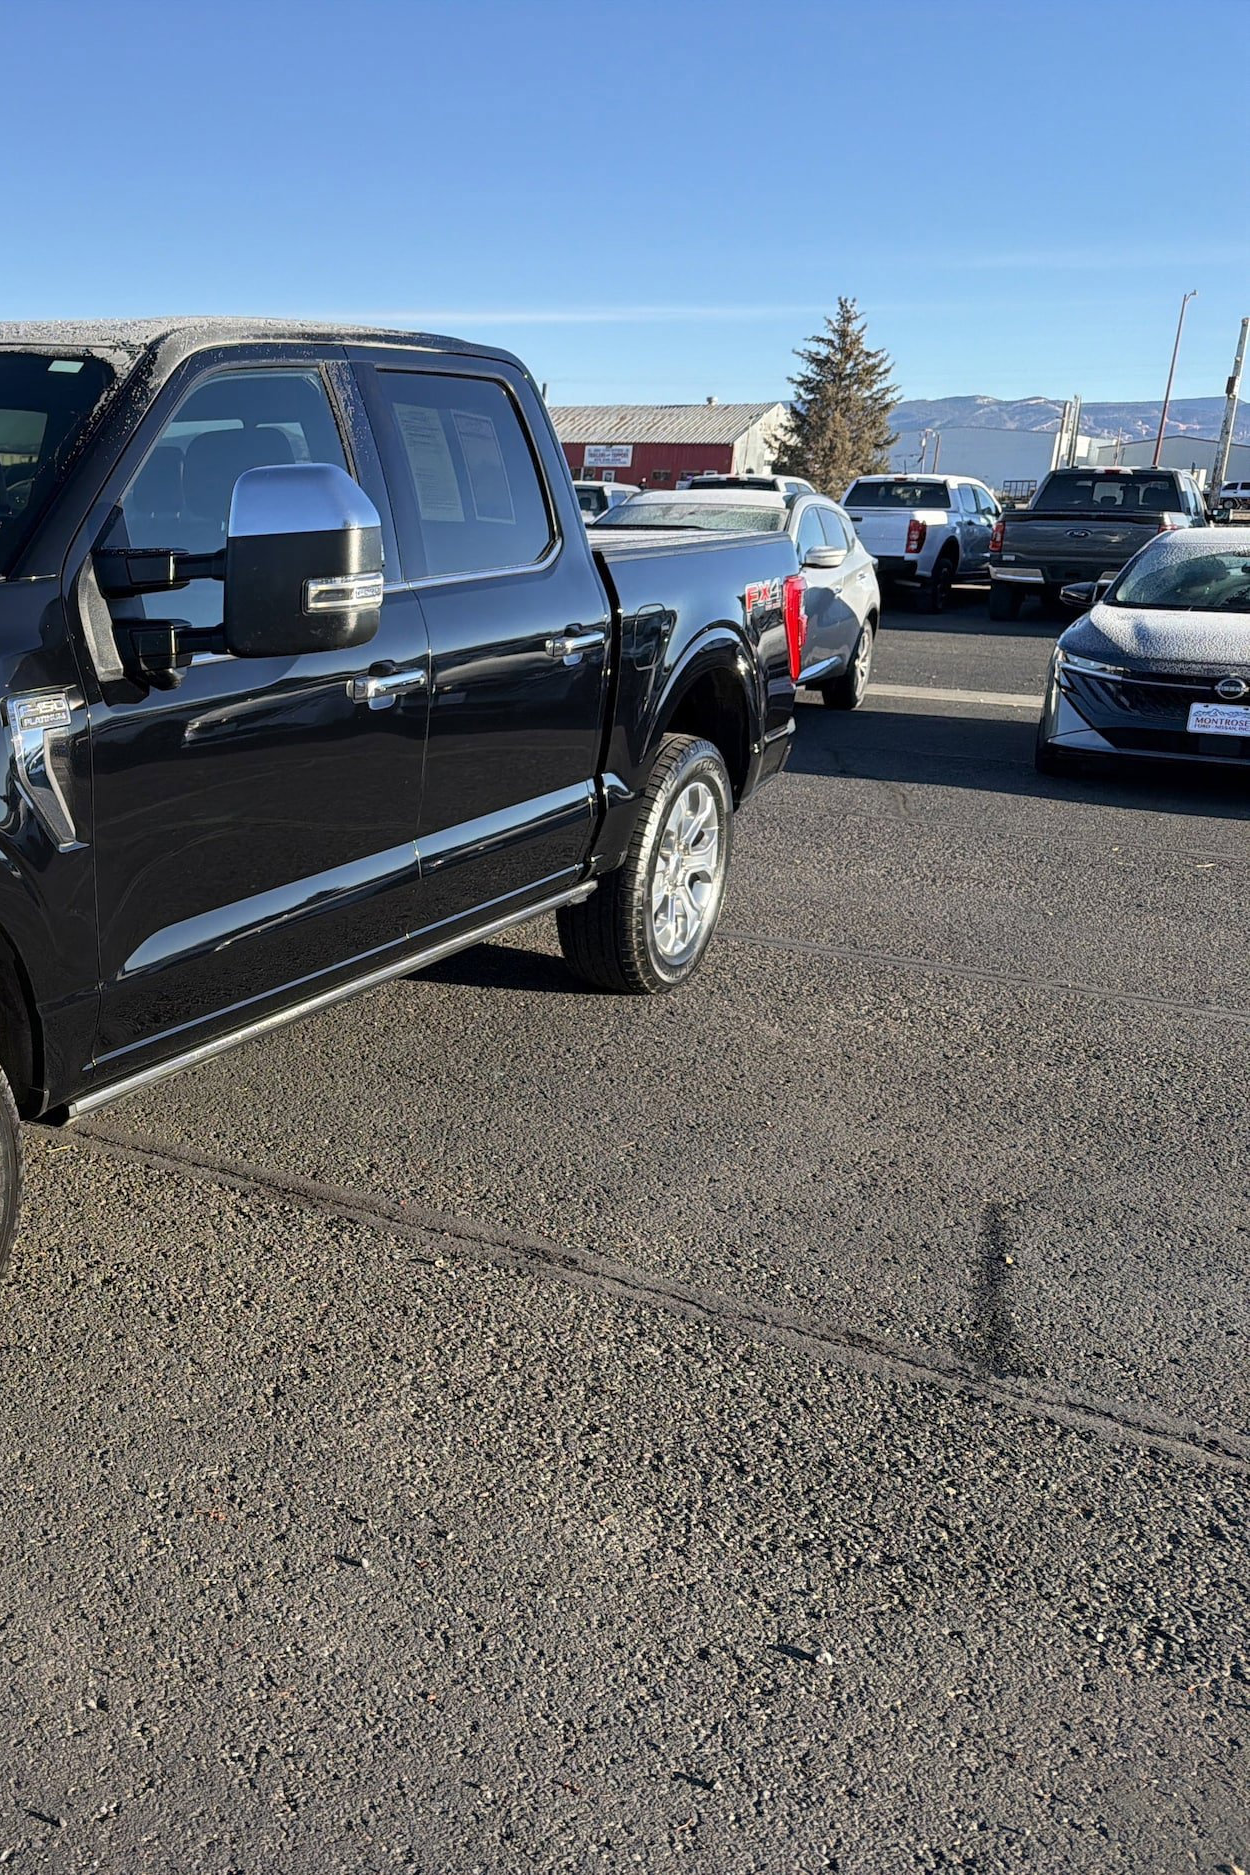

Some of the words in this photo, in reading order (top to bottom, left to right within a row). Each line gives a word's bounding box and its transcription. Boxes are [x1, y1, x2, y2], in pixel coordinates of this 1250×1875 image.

[745, 577, 781, 613] FX4
[19, 700, 65, 718] F-150
[23, 711, 66, 727] PLATINUM
[1195, 716, 1250, 728] MONTROSE
